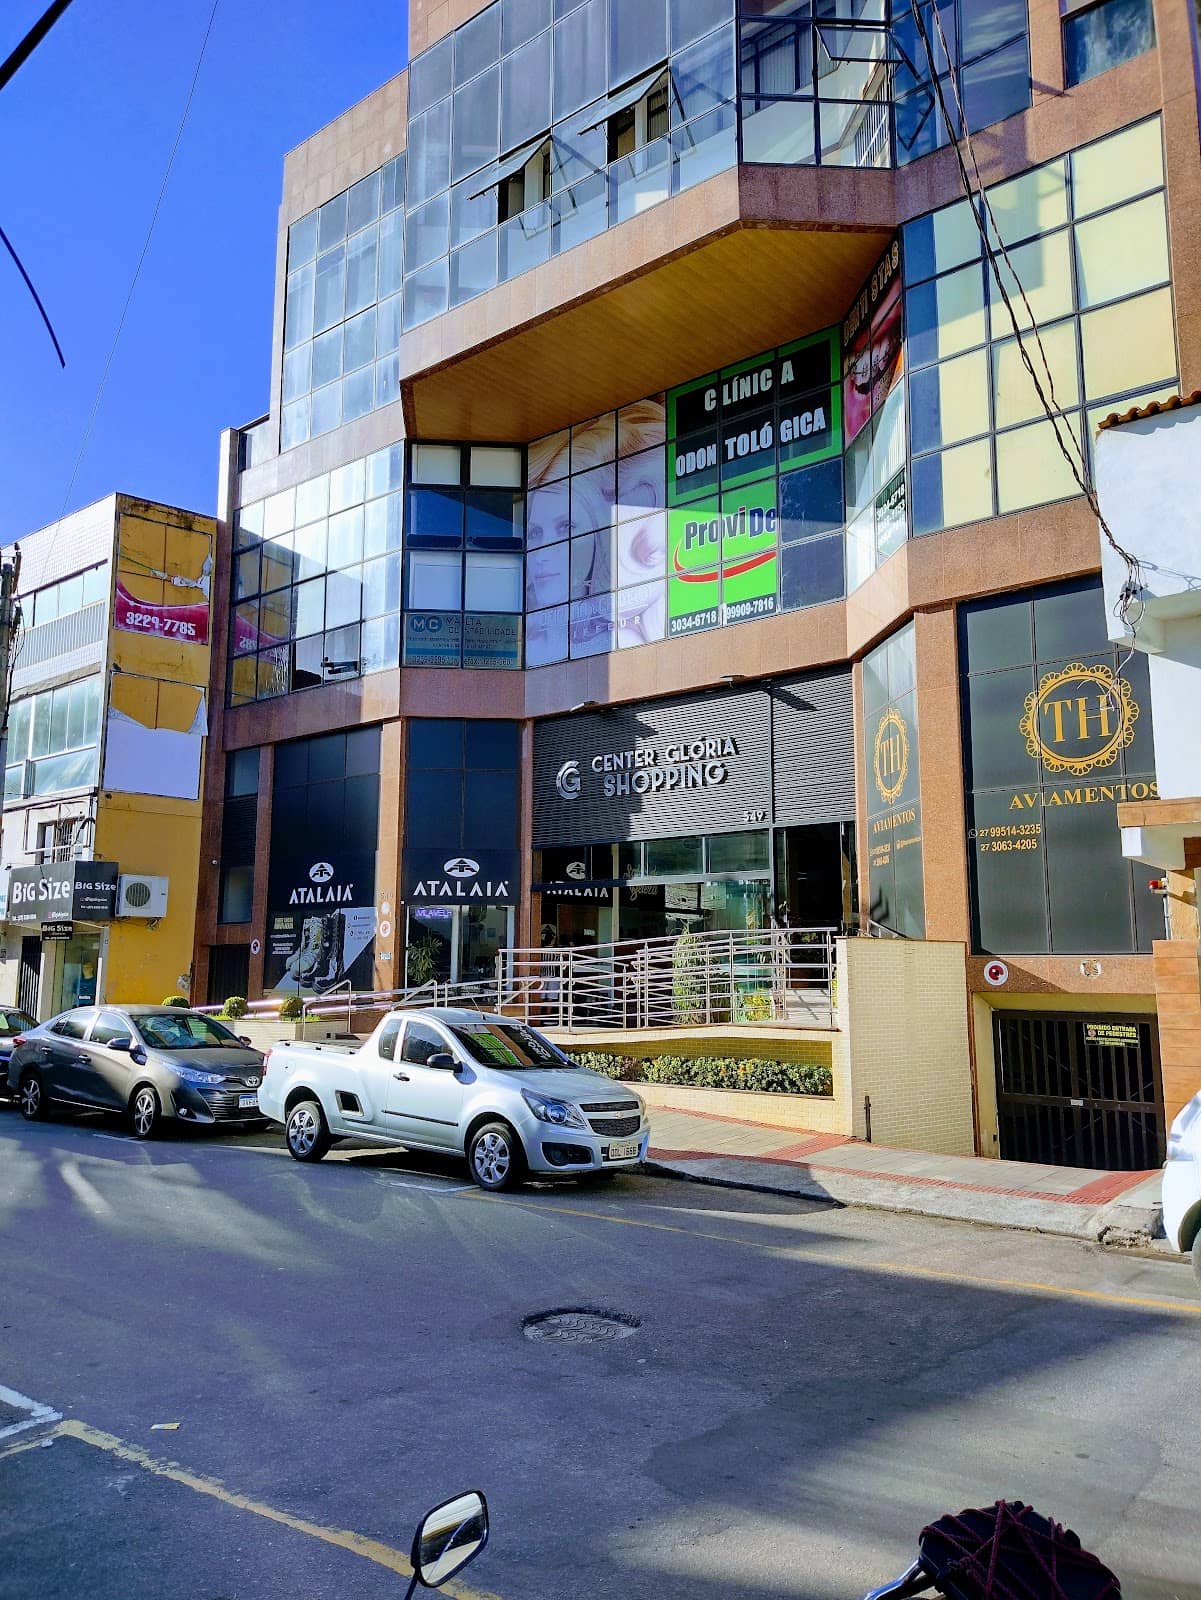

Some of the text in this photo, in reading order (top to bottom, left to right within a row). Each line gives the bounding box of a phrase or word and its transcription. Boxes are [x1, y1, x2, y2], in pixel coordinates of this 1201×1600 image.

[126, 611, 196, 636] 3229-7785
[671, 610, 717, 632] 3034-6718
[1043, 693, 1114, 743] TH
[591, 736, 737, 772] CENTER GLÓRIA
[603, 760, 725, 797] SHOPPING
[743, 809, 764, 822] 549
[980, 823, 1041, 837] 27 99514-3235
[981, 839, 1038, 852] 27 3063-4205
[289, 884, 353, 904] ATALAIA
[413, 880, 509, 897] ATALAIA
